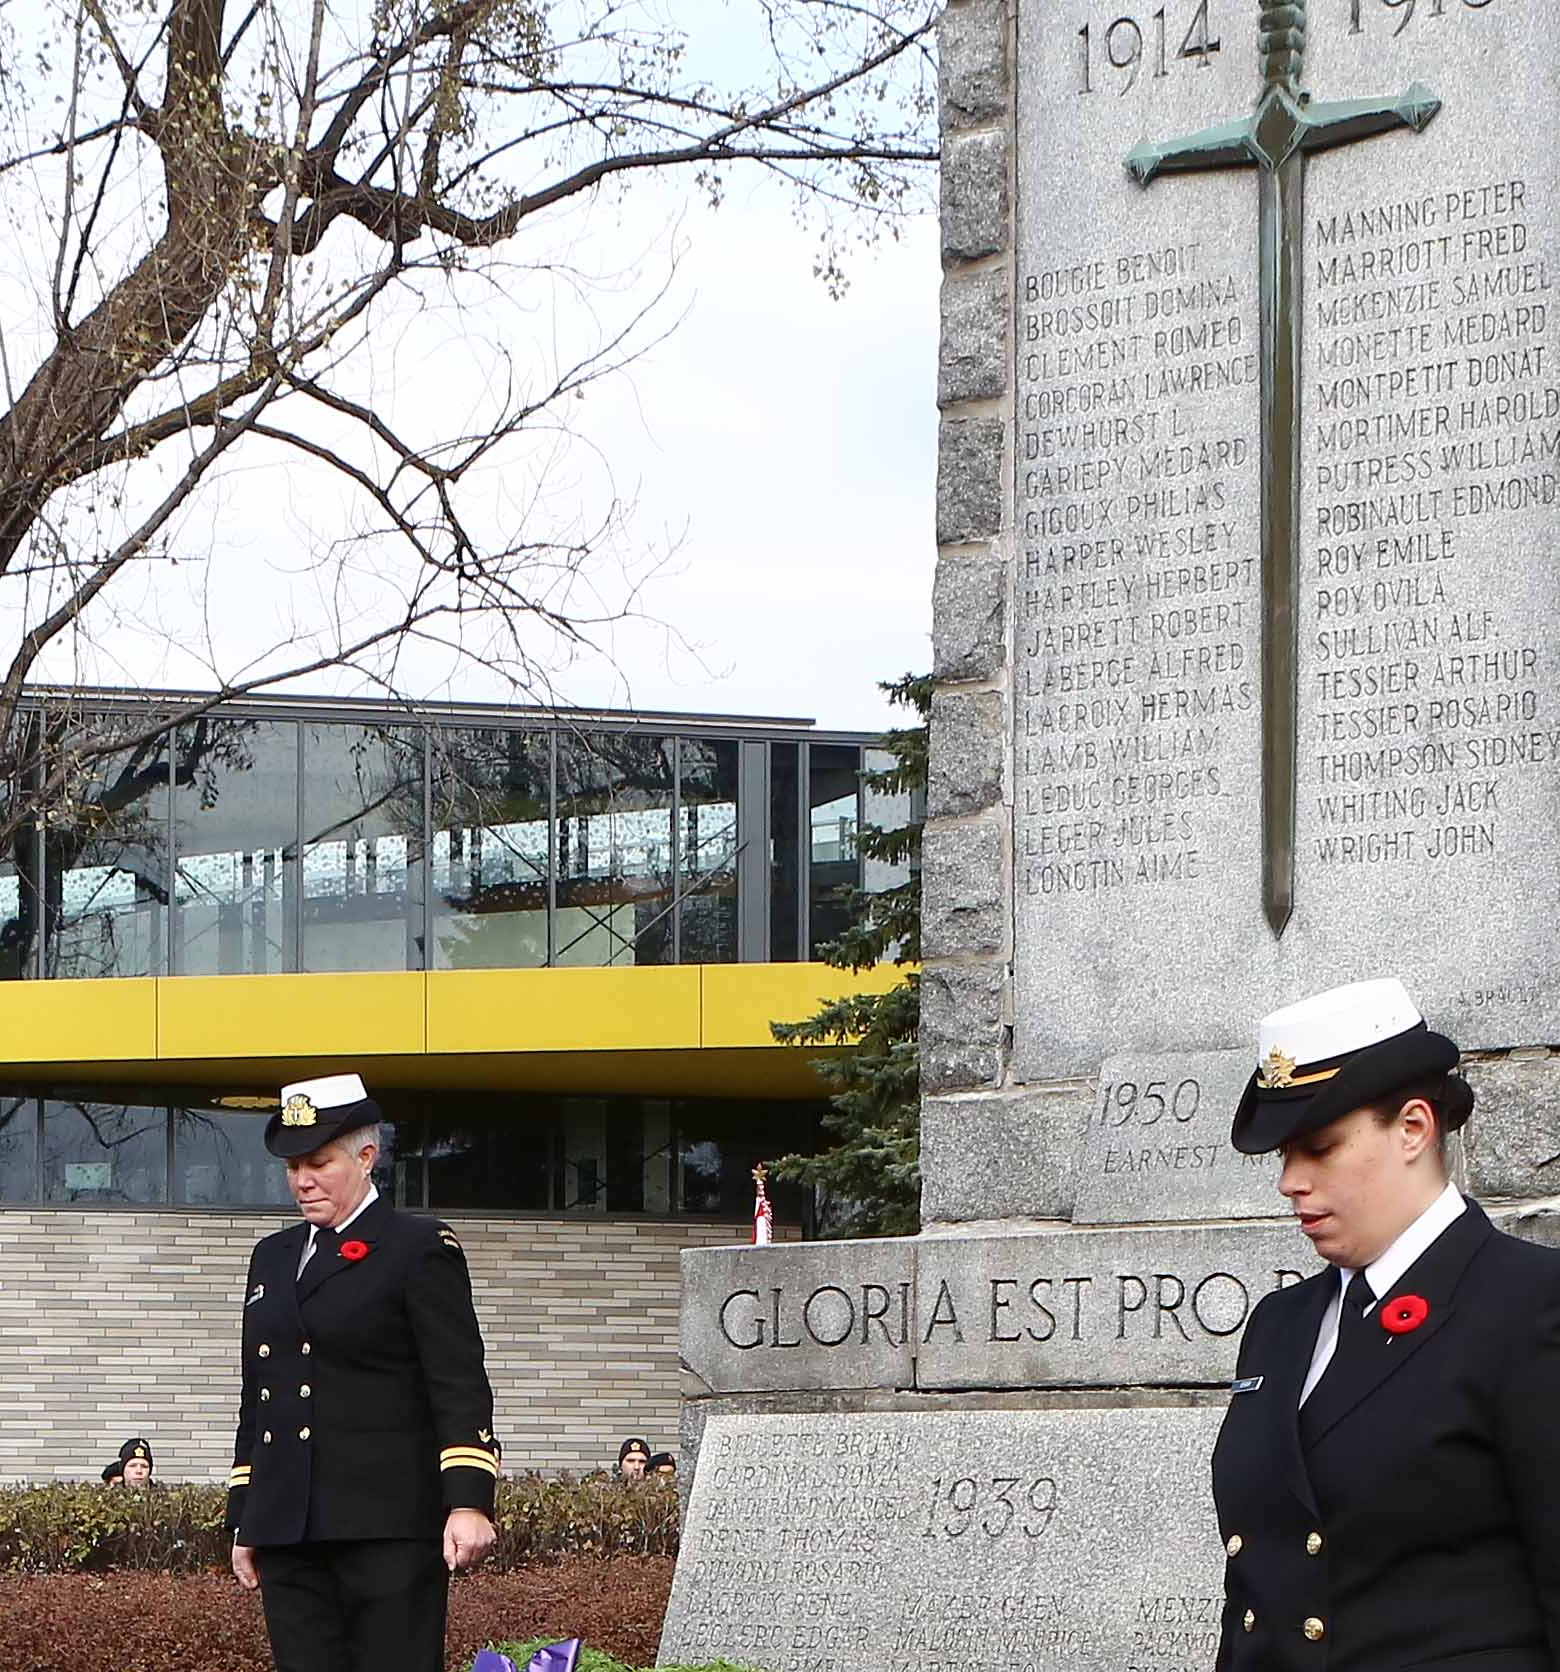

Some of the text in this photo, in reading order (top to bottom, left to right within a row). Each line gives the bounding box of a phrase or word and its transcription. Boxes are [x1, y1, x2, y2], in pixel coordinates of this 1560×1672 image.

[1078, 0, 1221, 96] 1914
[1317, 180, 1526, 248] MANNING PETER
[1026, 244, 1200, 302] BOUGIE BENOIT
[1317, 223, 1527, 288] MARRIOTT FRED
[1026, 275, 1238, 342] BROSSOIT DOMINA
[1451, 262, 1551, 306] SAMUEL
[1026, 316, 1242, 382] CLEMENT ROMEO
[1318, 304, 1546, 369] MONETTE MEDARD
[1026, 354, 1258, 421] CORCORAN LAWRENCE
[1318, 346, 1545, 412] MONTPETIT DONAT
[1026, 412, 1159, 461] DEWHURST
[1317, 388, 1559, 453] MORTIMER HAROLD
[1026, 438, 1247, 500] GARIEPY MEDARD
[1317, 450, 1433, 493] PUTRESS
[1026, 482, 1226, 539] GIGOUX PHILIAS
[1317, 474, 1556, 537] ROBINAULT EDMOND
[1026, 521, 1237, 579] HARPER WESLEY
[1317, 530, 1455, 577] ROY EMILE
[1026, 558, 1254, 618] HARTLEY HERBERT
[1317, 570, 1446, 621] ROY OVILA
[1027, 601, 1246, 658] JARRETT ROBERT
[1317, 610, 1500, 661] SULLIVAN ALF.
[1026, 643, 1244, 697] LABERGE ALFRED
[1317, 648, 1537, 701] TESSIER ARTHUR
[1026, 682, 1252, 737] LACROIX HERMAS
[1317, 690, 1536, 741] TESSIER ROSARIO
[1026, 727, 1220, 776] LAMB WILLIAM
[1317, 742, 1455, 784] THOMPSON
[1026, 767, 1221, 816] LEDUC GEORGES
[1317, 780, 1499, 824] WHITING JACK
[1026, 811, 1193, 856] LEGER JULES
[1317, 823, 1495, 864] WRIGHT JOHN
[1026, 850, 1199, 895] LONGTIN AIME
[1099, 1078, 1202, 1128] 1950
[1103, 1143, 1225, 1174] EARNEST
[718, 1279, 967, 1350] GLORIA
[986, 1276, 1091, 1342] EST
[1115, 1272, 1249, 1342] PRO
[712, 1463, 902, 1490] CARDINAL ROMA
[921, 1477, 1059, 1538] 1939
[777, 1527, 877, 1553] THOMAS
[680, 1622, 870, 1650] LECLERC EDGAR
[1134, 1597, 1225, 1623] MENZI
